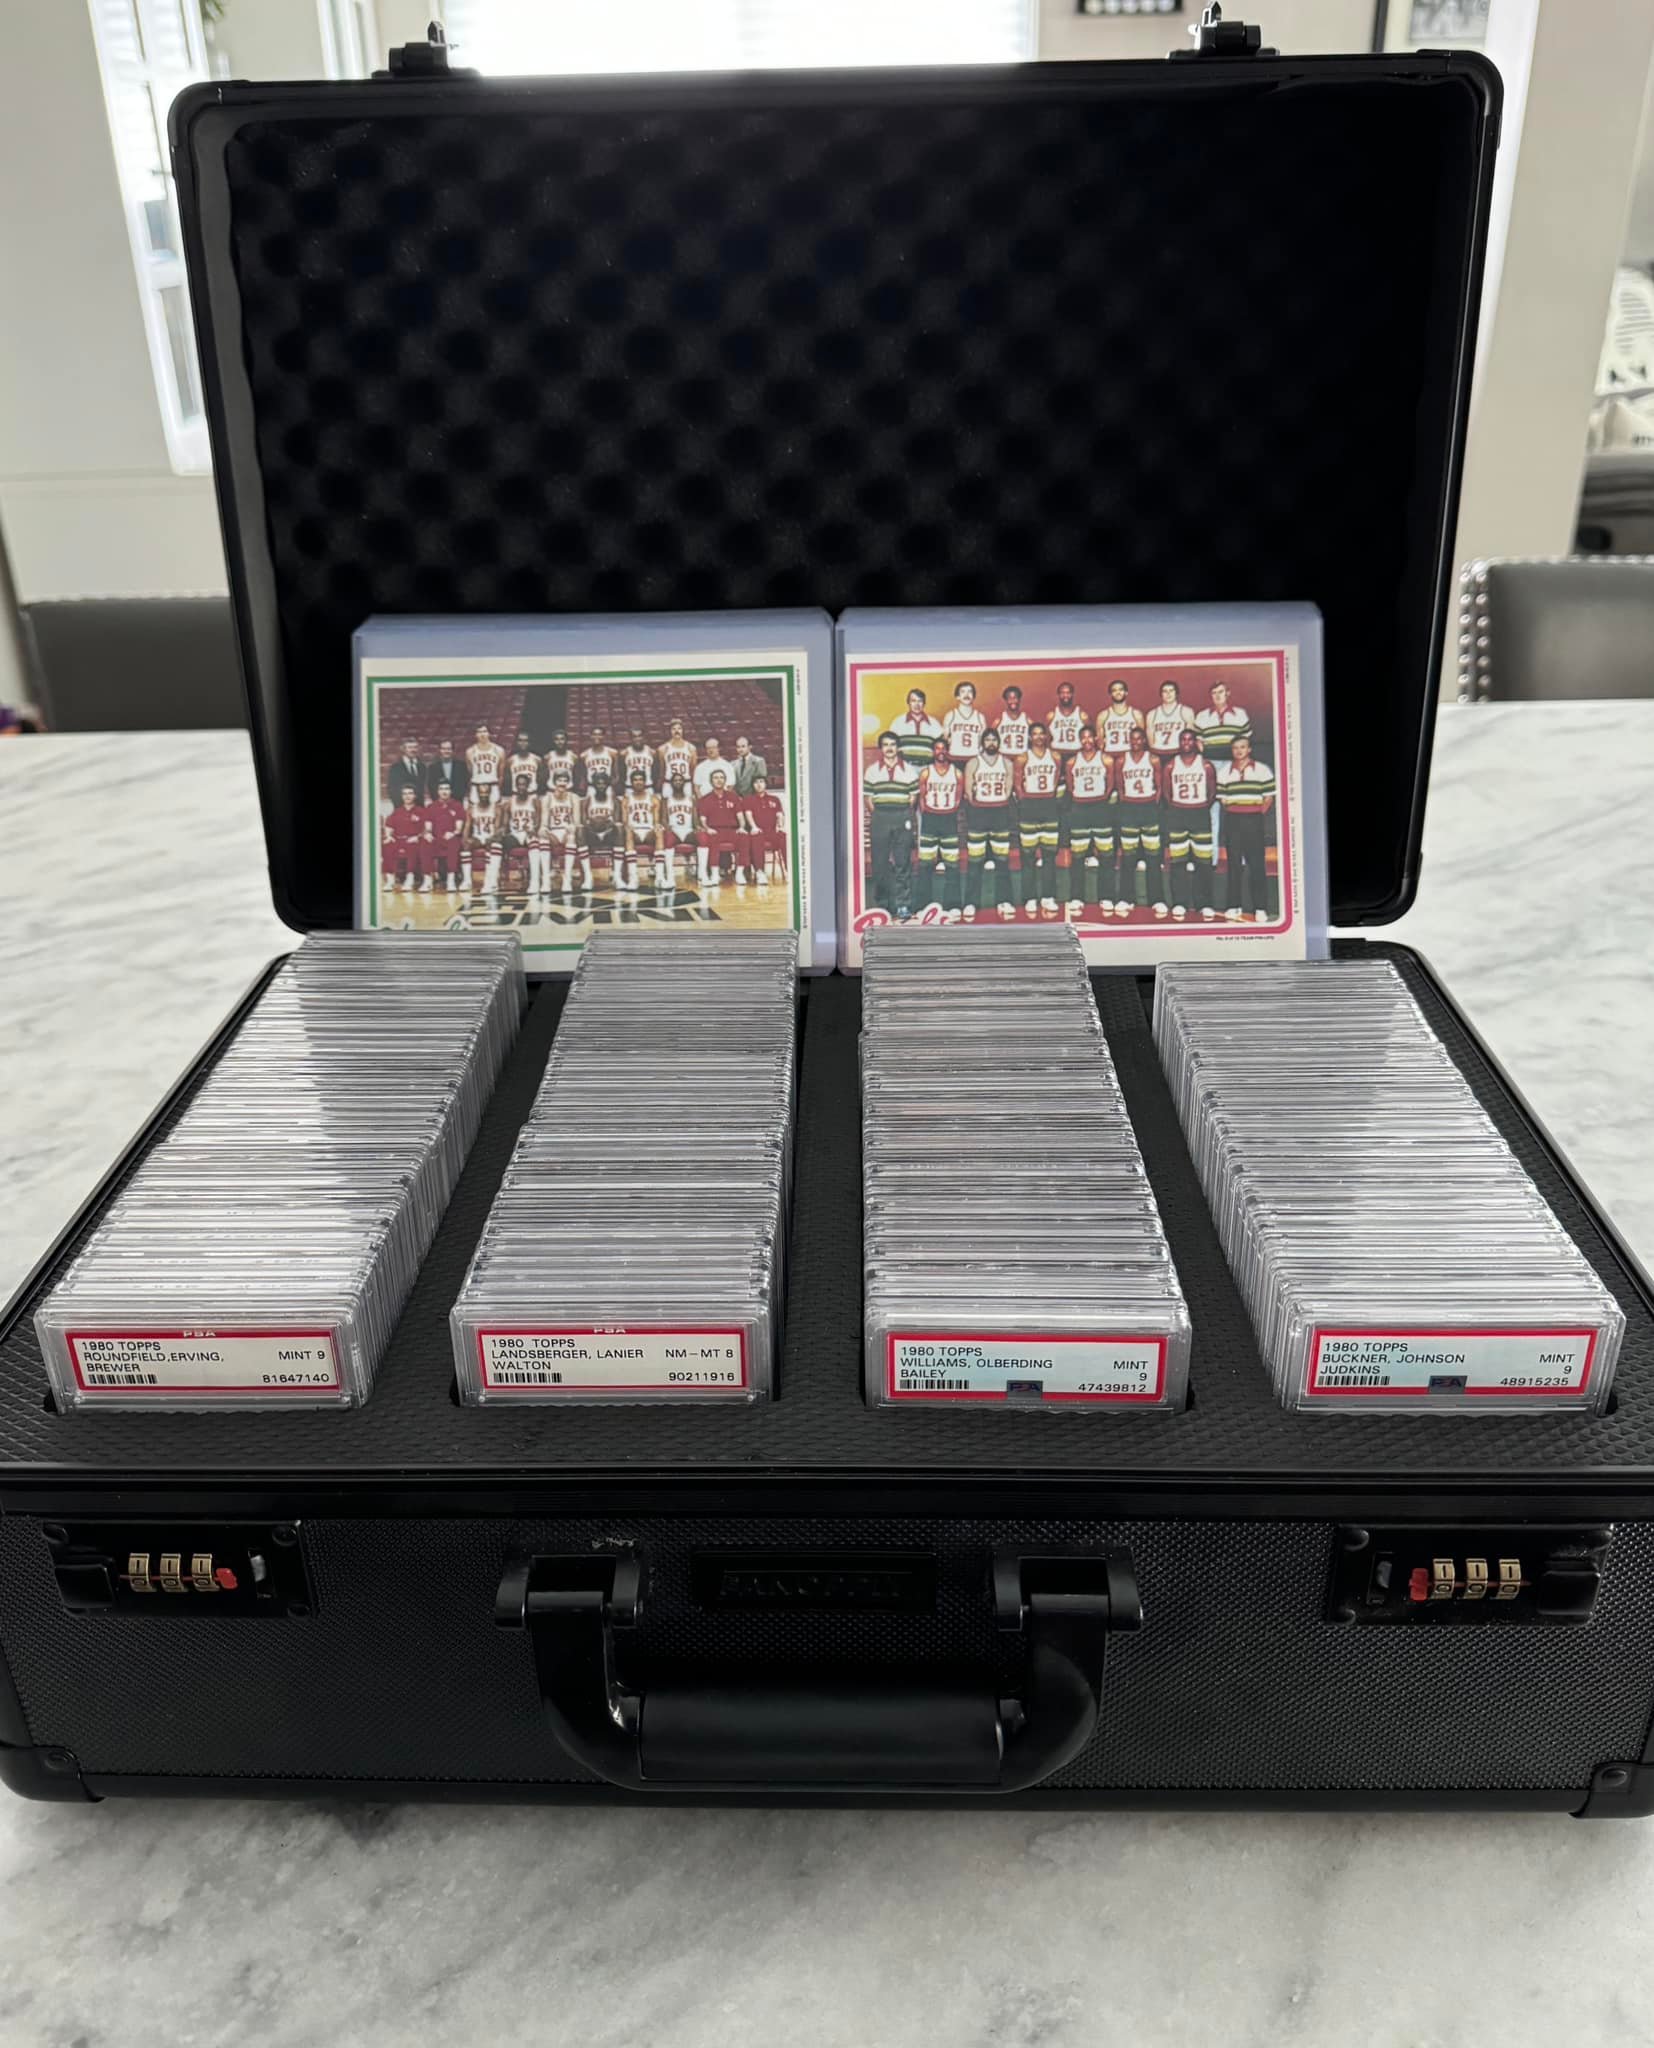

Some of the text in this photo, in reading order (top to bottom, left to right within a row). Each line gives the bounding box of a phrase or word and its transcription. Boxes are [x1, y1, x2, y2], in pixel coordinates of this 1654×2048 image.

[953, 723, 979, 733] BUCKS
[1000, 724, 1026, 734] BUCKS
[1155, 722, 1181, 731] BUCKS
[1059, 727, 1076, 742] 16
[1110, 731, 1130, 745] 31
[1162, 731, 1171, 745] 7
[962, 733, 972, 747] 6
[1003, 734, 1025, 749] 42
[477, 761, 492, 775] 10
[671, 763, 687, 775] 50
[1027, 765, 1054, 776] BUCKS
[1075, 767, 1101, 777] BUCKS
[1124, 769, 1151, 779] BUCKS
[1038, 775, 1047, 790] 8
[1084, 777, 1094, 791] 2
[1134, 780, 1144, 794] 4
[1178, 783, 1199, 799] 21
[933, 793, 950, 807] 11
[632, 811, 648, 824] 41
[676, 814, 686, 825] 3
[82, 1342, 161, 1351] 1980 TOPPS
[492, 1339, 575, 1348] 1980 TOPPS
[1325, 1343, 1408, 1352] 1980 TOPPS
[278, 1351, 325, 1360] MINT 9
[492, 1349, 644, 1360] LANDSBERGER, LANIER
[726, 1349, 734, 1358] 8
[901, 1347, 982, 1356] 1980 TOPPS
[901, 1358, 1053, 1368] WILLIAMS, OLBERDING
[1322, 1354, 1465, 1364] BUCKNER, JOHNSON
[1539, 1354, 1575, 1363] MINT
[87, 1363, 141, 1372] BREWER
[493, 1361, 551, 1370] WALTON
[1113, 1361, 1148, 1370] MINT
[1320, 1365, 1380, 1374] JUDKINS
[1563, 1365, 1572, 1374] 9
[263, 1374, 329, 1383] 81647140
[668, 1373, 735, 1381] 90211916
[901, 1370, 946, 1378] BAILEY
[1139, 1372, 1147, 1381] 9
[1500, 1377, 1569, 1386] 48915235
[1078, 1383, 1146, 1392] 47439812
